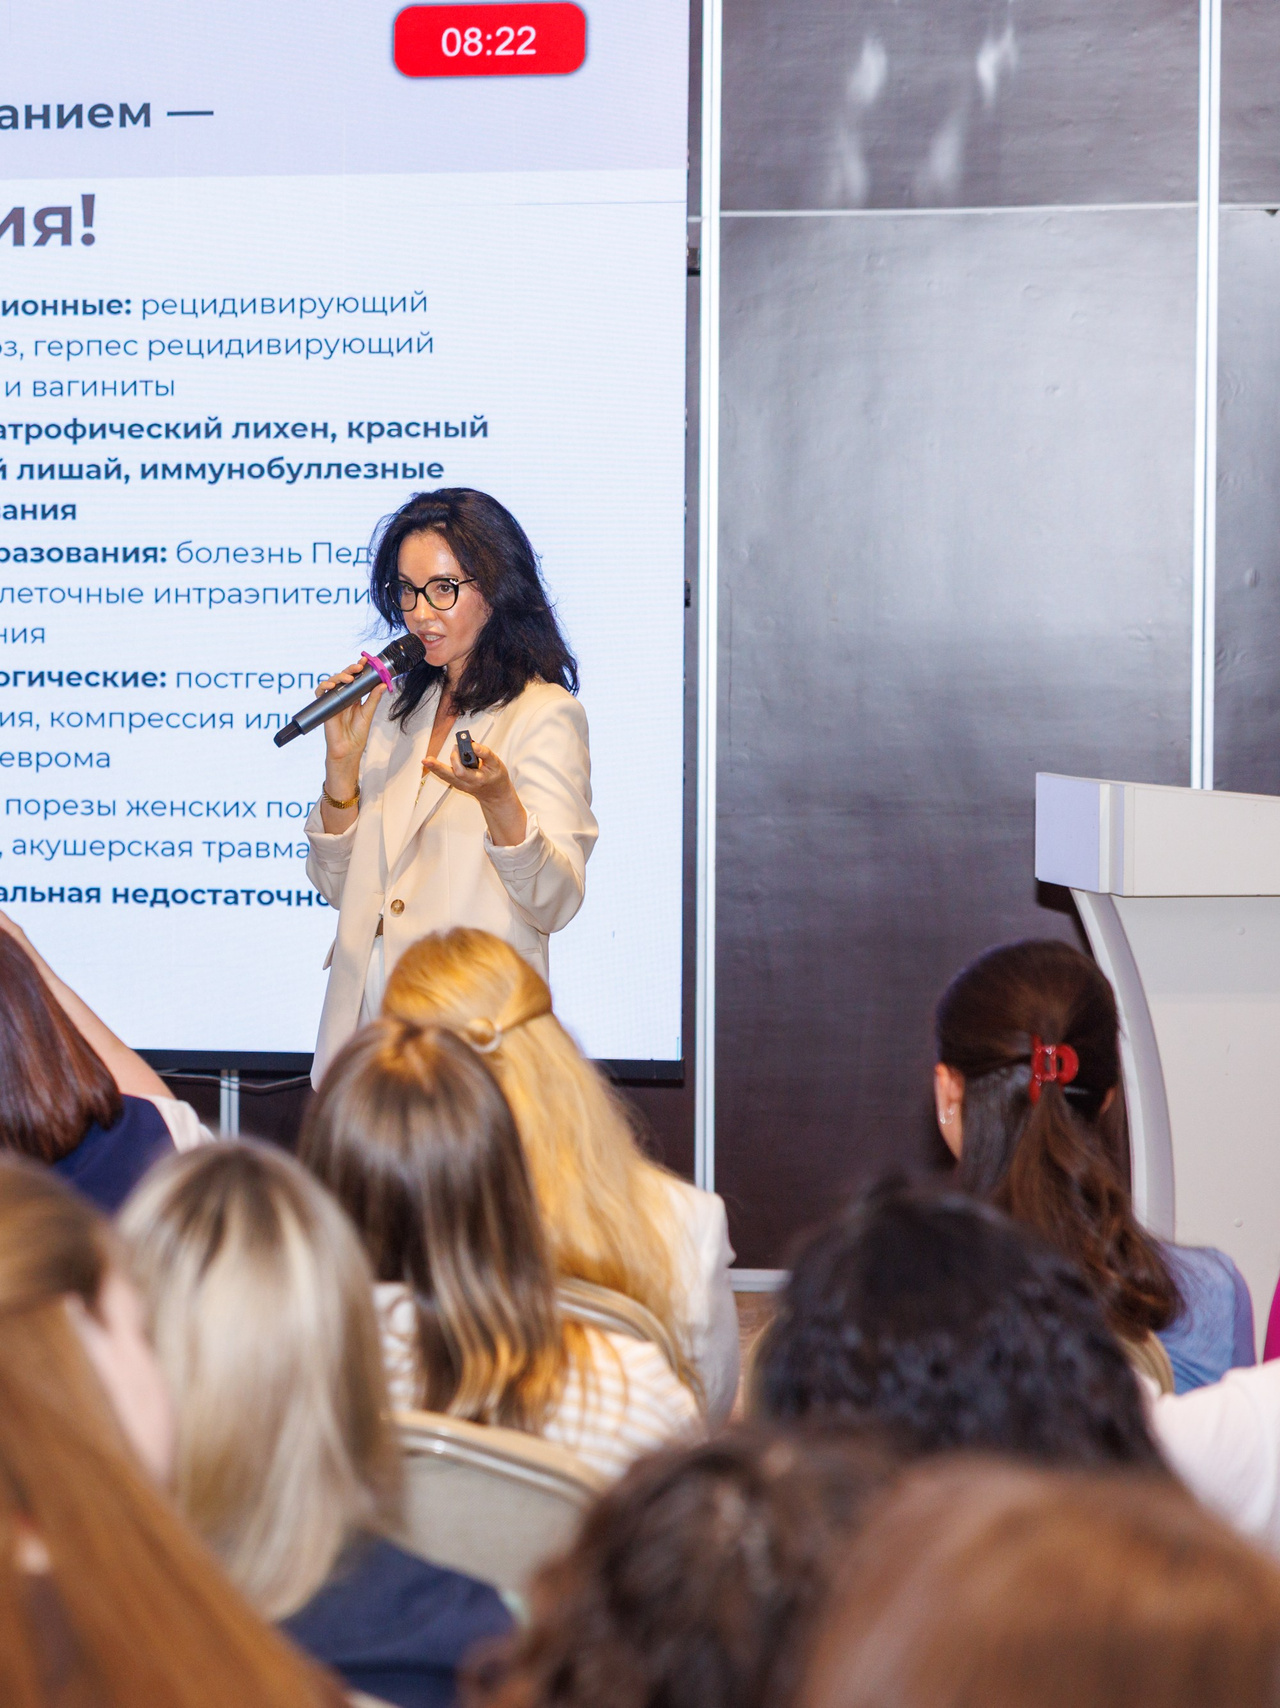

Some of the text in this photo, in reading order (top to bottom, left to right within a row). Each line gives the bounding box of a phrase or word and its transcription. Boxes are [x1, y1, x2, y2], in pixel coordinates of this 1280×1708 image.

[441, 26, 536, 57] 08:22
[142, 290, 427, 320] рецидивирующий
[34, 339, 138, 362] герпес
[148, 331, 433, 361] рецидивирующий
[4, 380, 21, 397] и
[32, 379, 174, 397] вагиниты
[231, 421, 337, 444] лихен,
[347, 414, 488, 444] красный
[15, 457, 130, 484] лишай,
[140, 455, 444, 485] иммунобуллезные
[176, 540, 302, 564] болезнь
[313, 542, 371, 567] Пед
[154, 587, 370, 610] интраэпители
[176, 672, 333, 694] постгерпе
[50, 711, 234, 734] компрессия
[5, 798, 116, 821] порезы
[126, 800, 256, 818] женских
[267, 801, 316, 818] пол
[11, 838, 192, 862] акушерская
[111, 884, 330, 908] недостаточно
